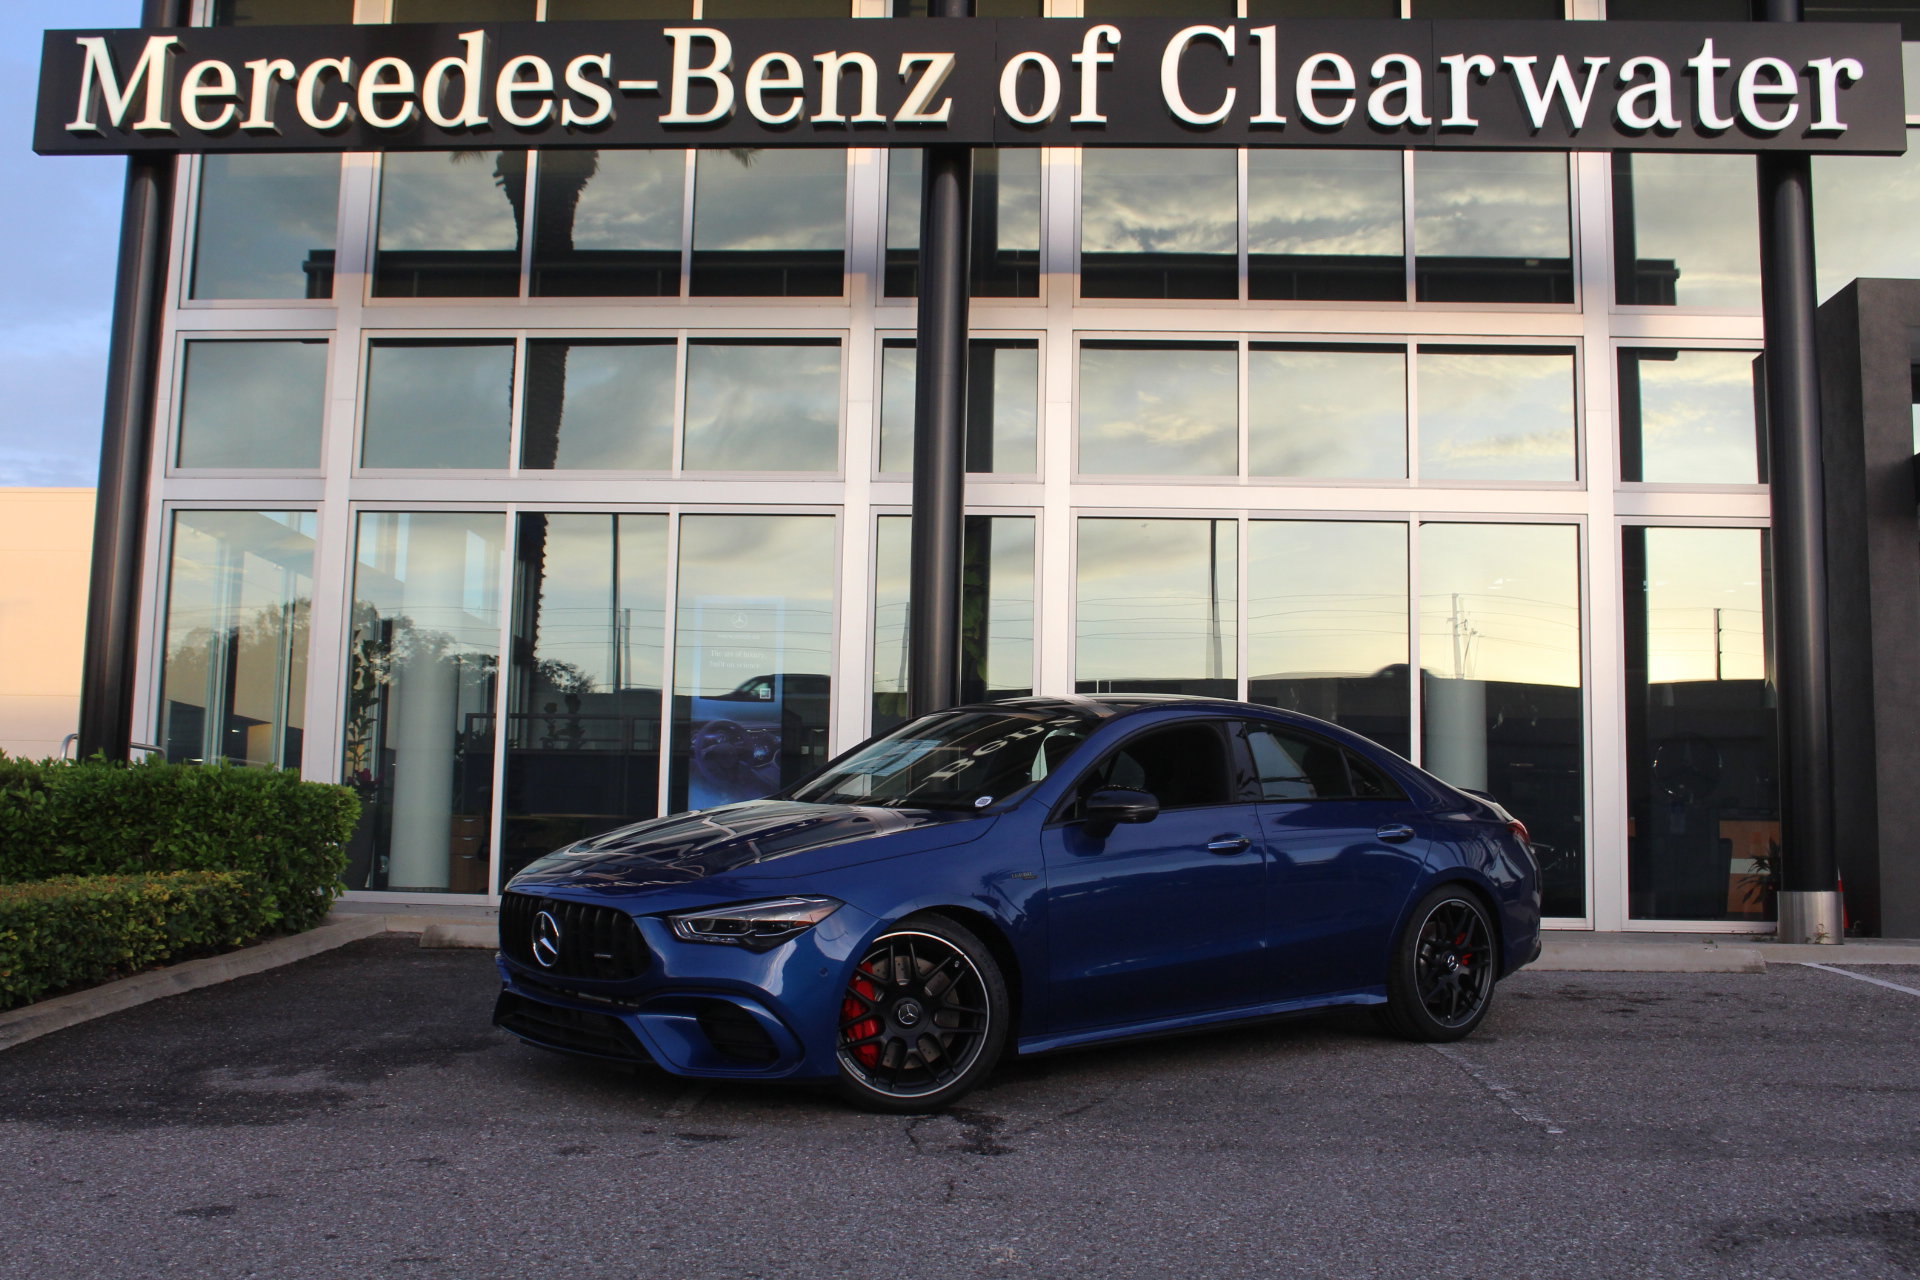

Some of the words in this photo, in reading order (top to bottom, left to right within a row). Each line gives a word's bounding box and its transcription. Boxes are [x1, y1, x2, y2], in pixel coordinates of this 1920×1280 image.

[65, 27, 955, 131] Mercedes-Benz
[999, 24, 1122, 125] of
[1160, 25, 1865, 132] Clearwater
